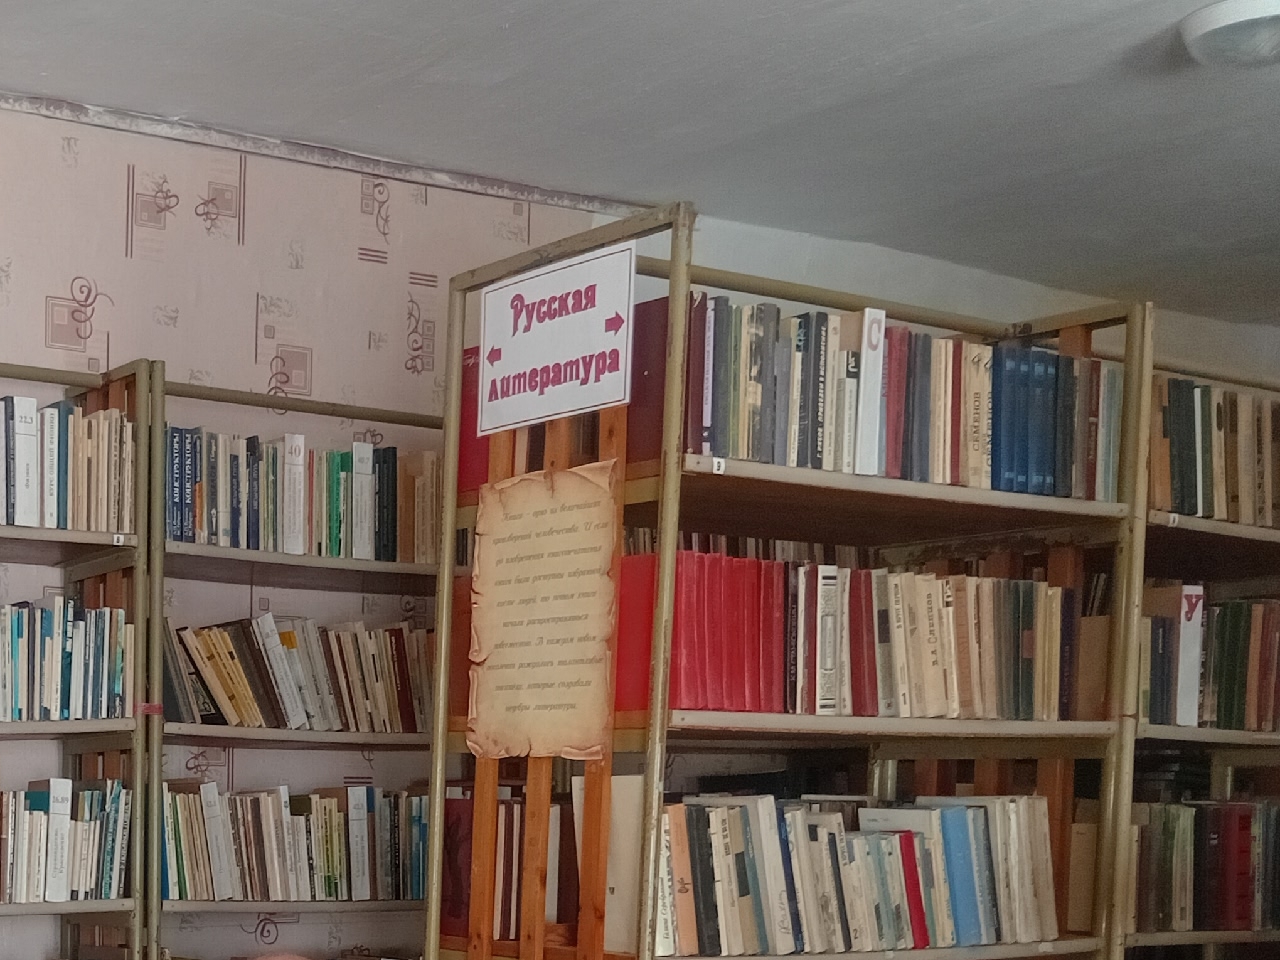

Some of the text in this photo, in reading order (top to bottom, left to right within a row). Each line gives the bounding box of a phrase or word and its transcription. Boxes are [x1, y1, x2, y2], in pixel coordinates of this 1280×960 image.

[511, 284, 596, 336] Русская
[972, 392, 981, 452] СЕМЕНОВ
[288, 445, 300, 457] 40
[1184, 593, 1203, 622] У
[901, 692, 907, 705] 1
